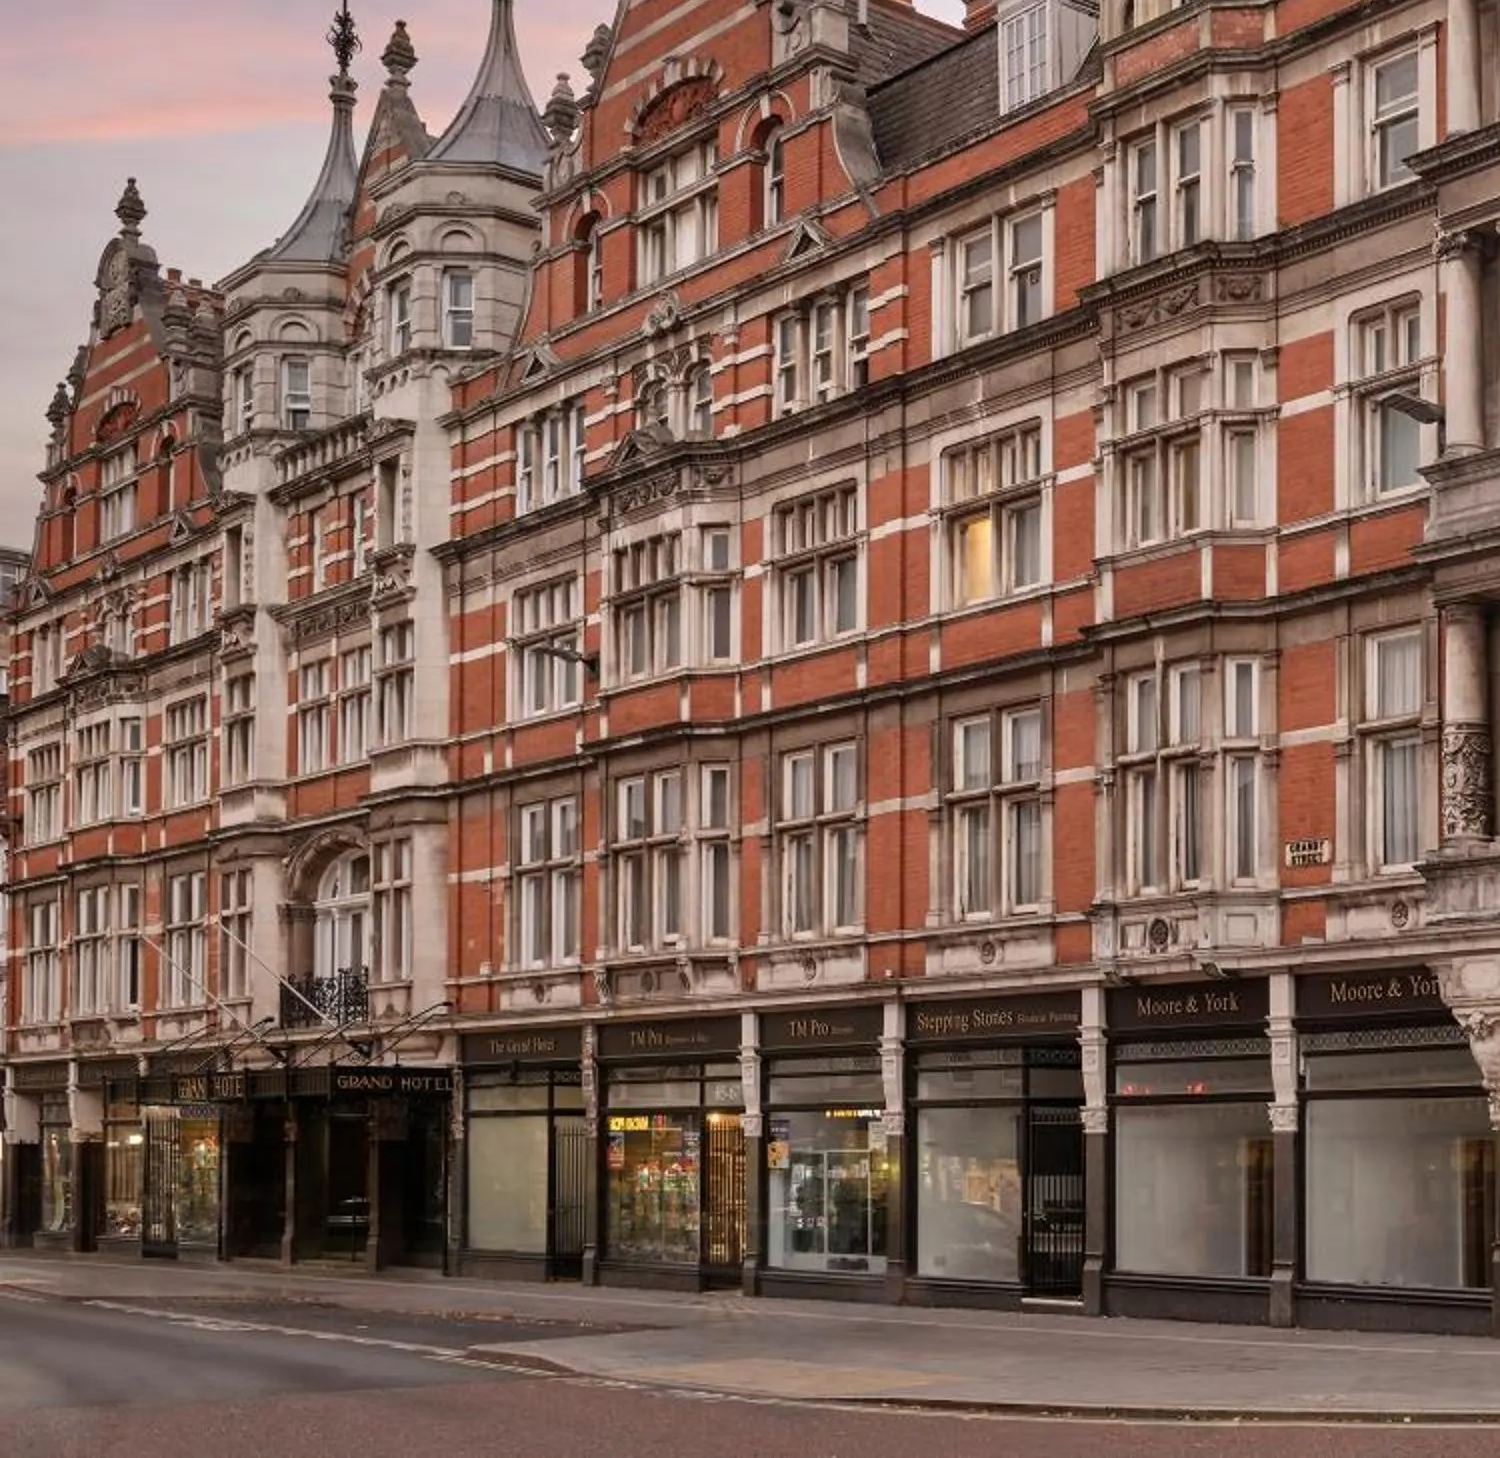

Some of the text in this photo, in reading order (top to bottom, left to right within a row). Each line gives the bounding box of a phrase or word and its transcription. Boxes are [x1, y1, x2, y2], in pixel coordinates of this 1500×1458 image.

[1291, 853, 1323, 865] STREET
[1329, 975, 1439, 1002] Moore & Yor
[1137, 992, 1240, 1016] Moore & York
[917, 1013, 969, 1033] Stepping
[972, 1009, 1013, 1028] Stones
[337, 1075, 454, 1091] GRAND HOTEL
